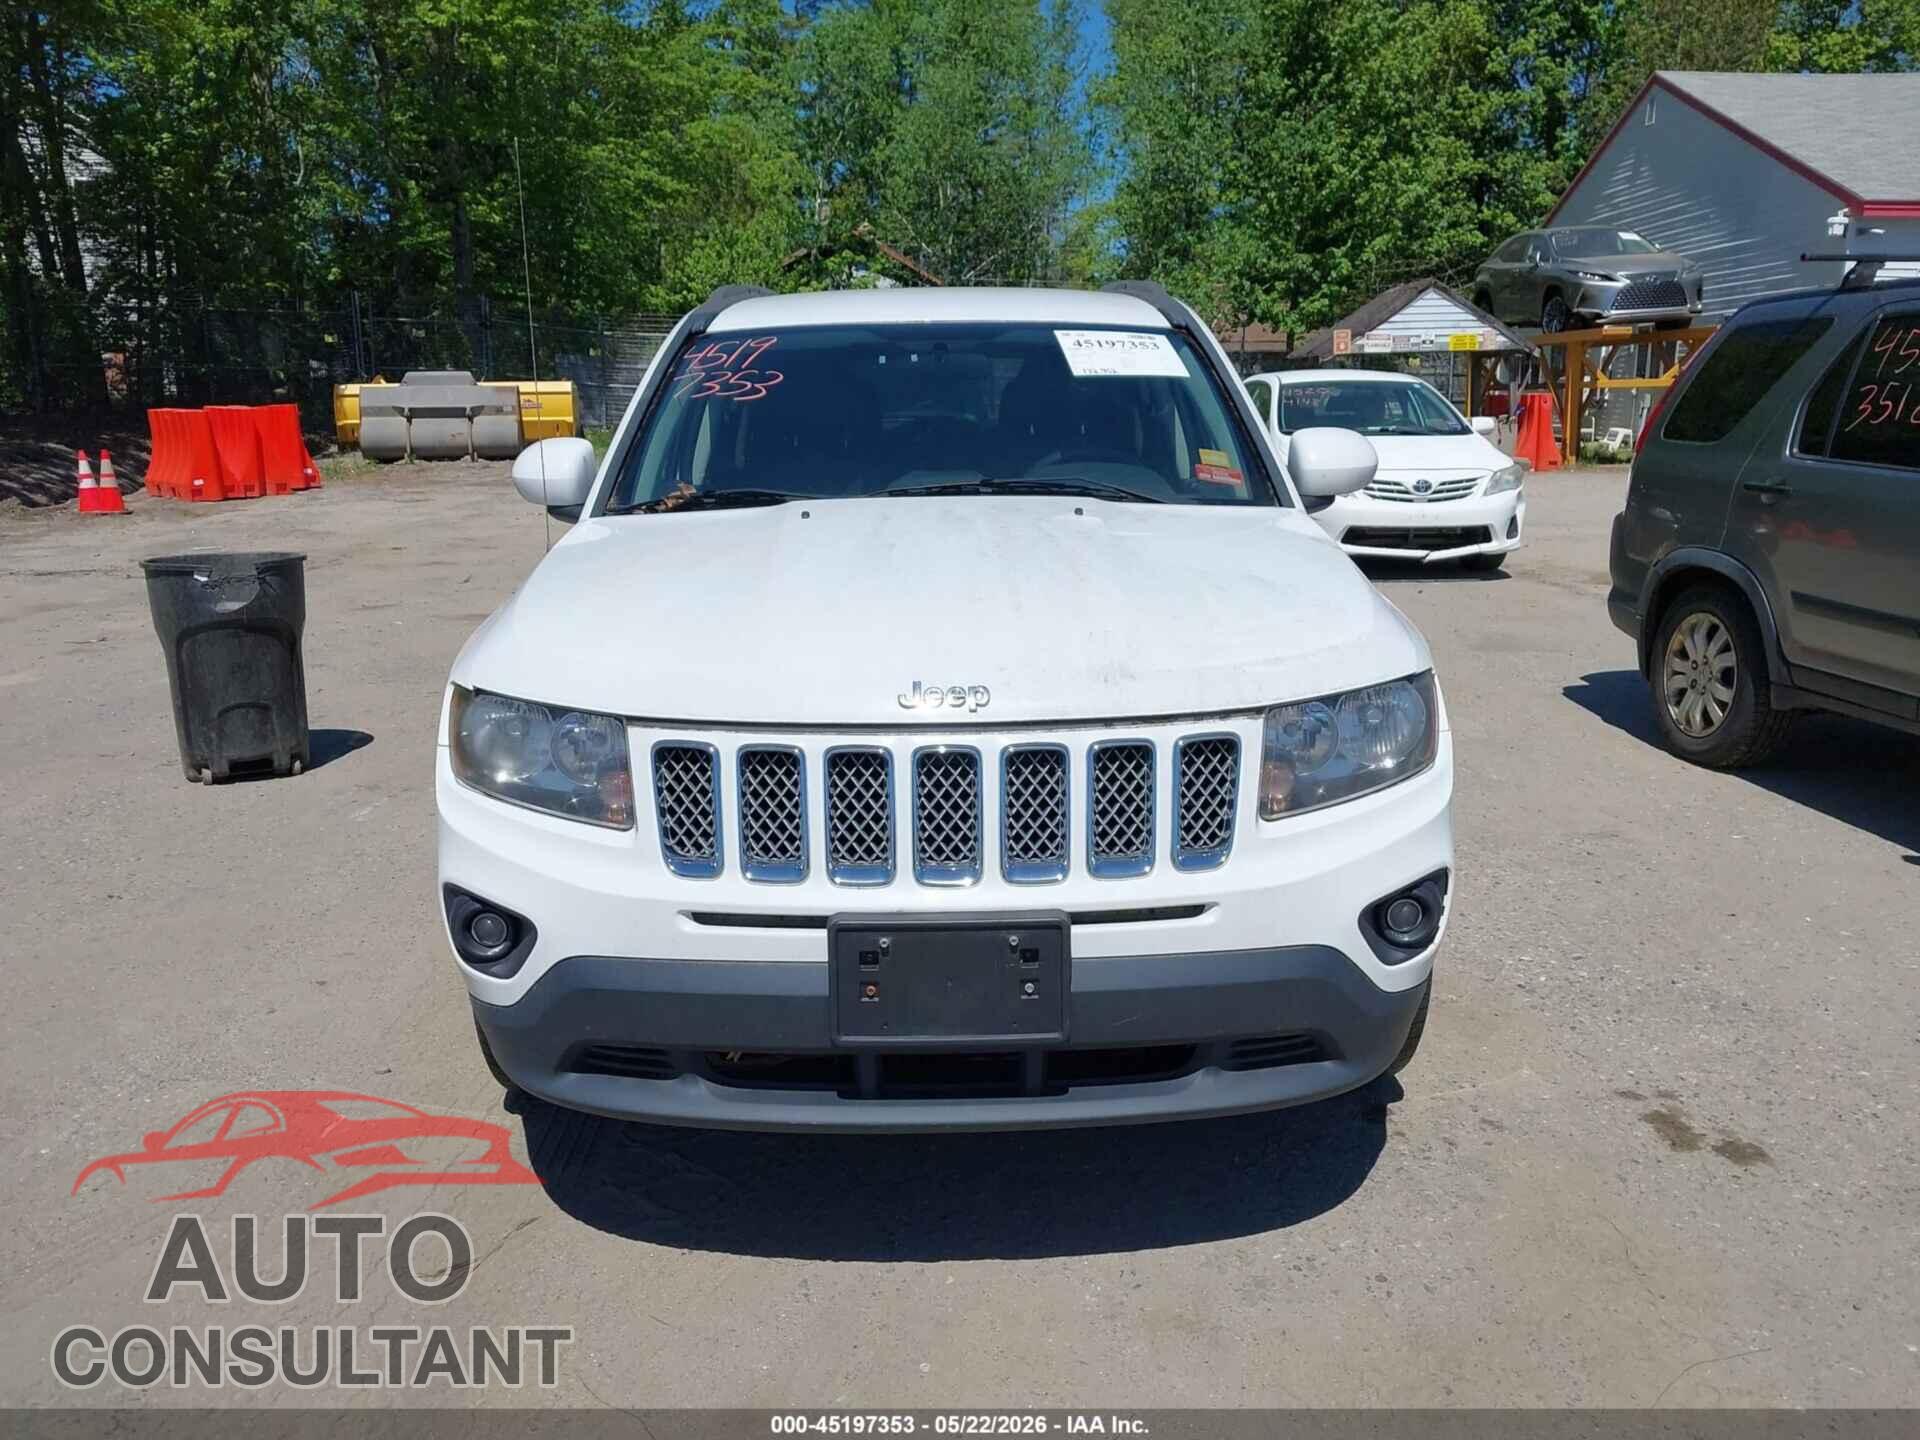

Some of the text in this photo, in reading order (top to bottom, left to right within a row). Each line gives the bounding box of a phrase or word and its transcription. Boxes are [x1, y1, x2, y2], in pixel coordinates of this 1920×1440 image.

[683, 336, 778, 372] 4519
[1073, 339, 1160, 350] 45197353
[673, 369, 784, 400] 7353
[897, 680, 990, 713] Jeep
